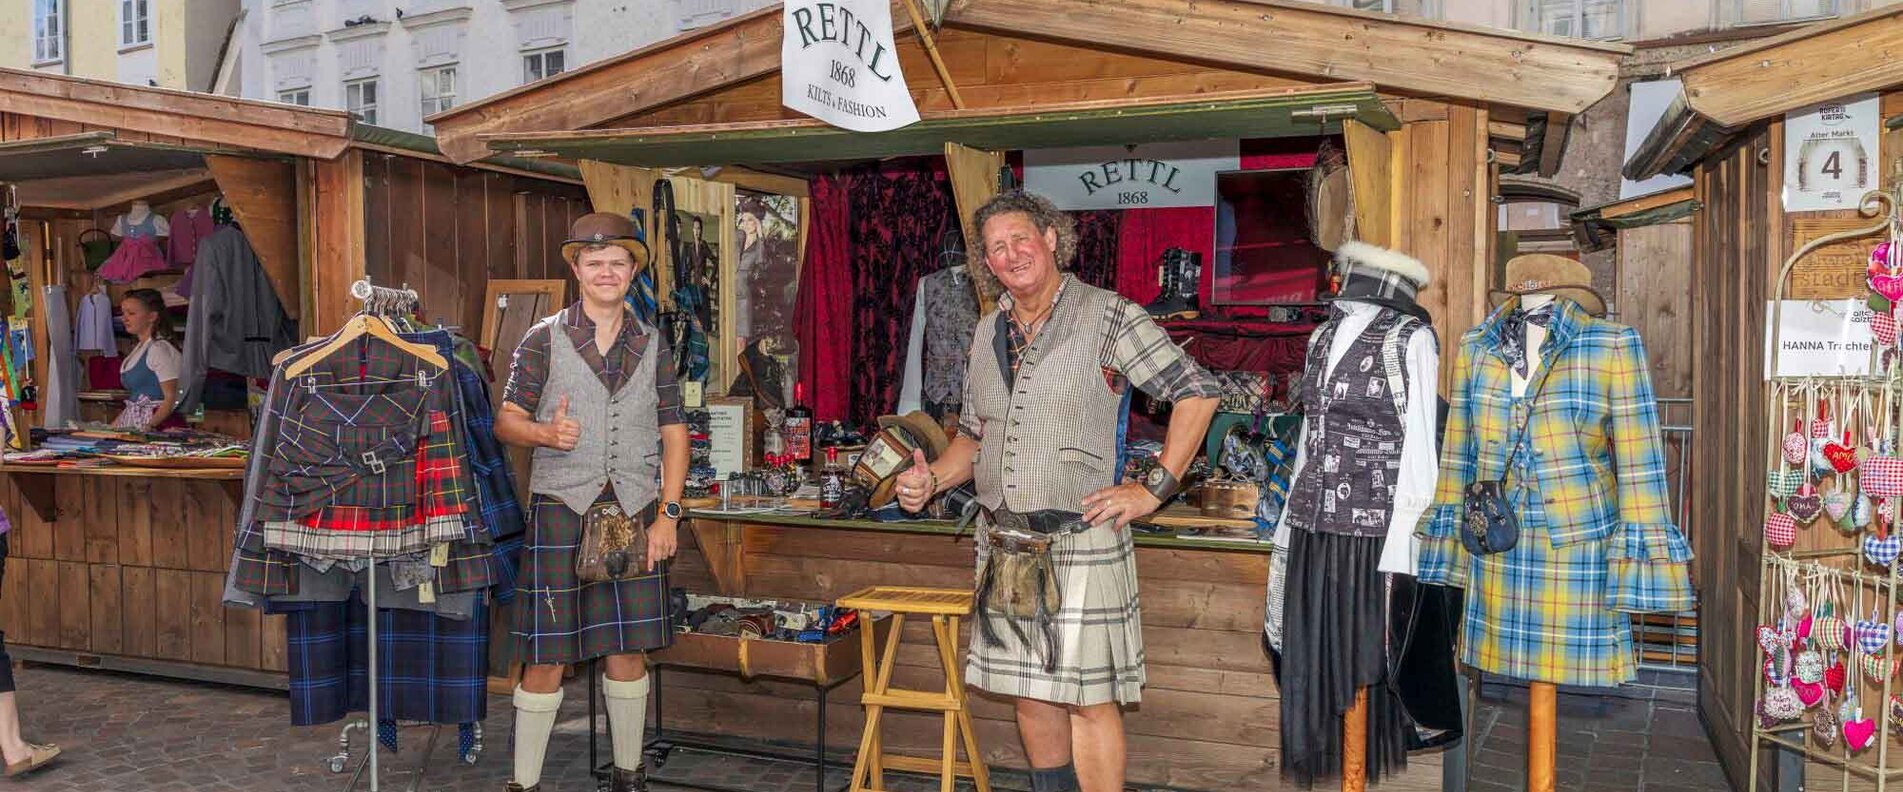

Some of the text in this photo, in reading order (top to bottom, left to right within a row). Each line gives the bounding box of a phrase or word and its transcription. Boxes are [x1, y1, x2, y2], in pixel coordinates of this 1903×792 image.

[792, 3, 892, 82] RETTL
[829, 59, 856, 88] 1868
[807, 83, 832, 106] KILTS
[837, 96, 887, 118] FASHION
[1078, 159, 1181, 195] RETTL
[1821, 150, 1842, 180] 4
[1118, 191, 1149, 204] 1868
[1783, 341, 1825, 350] HANNA
